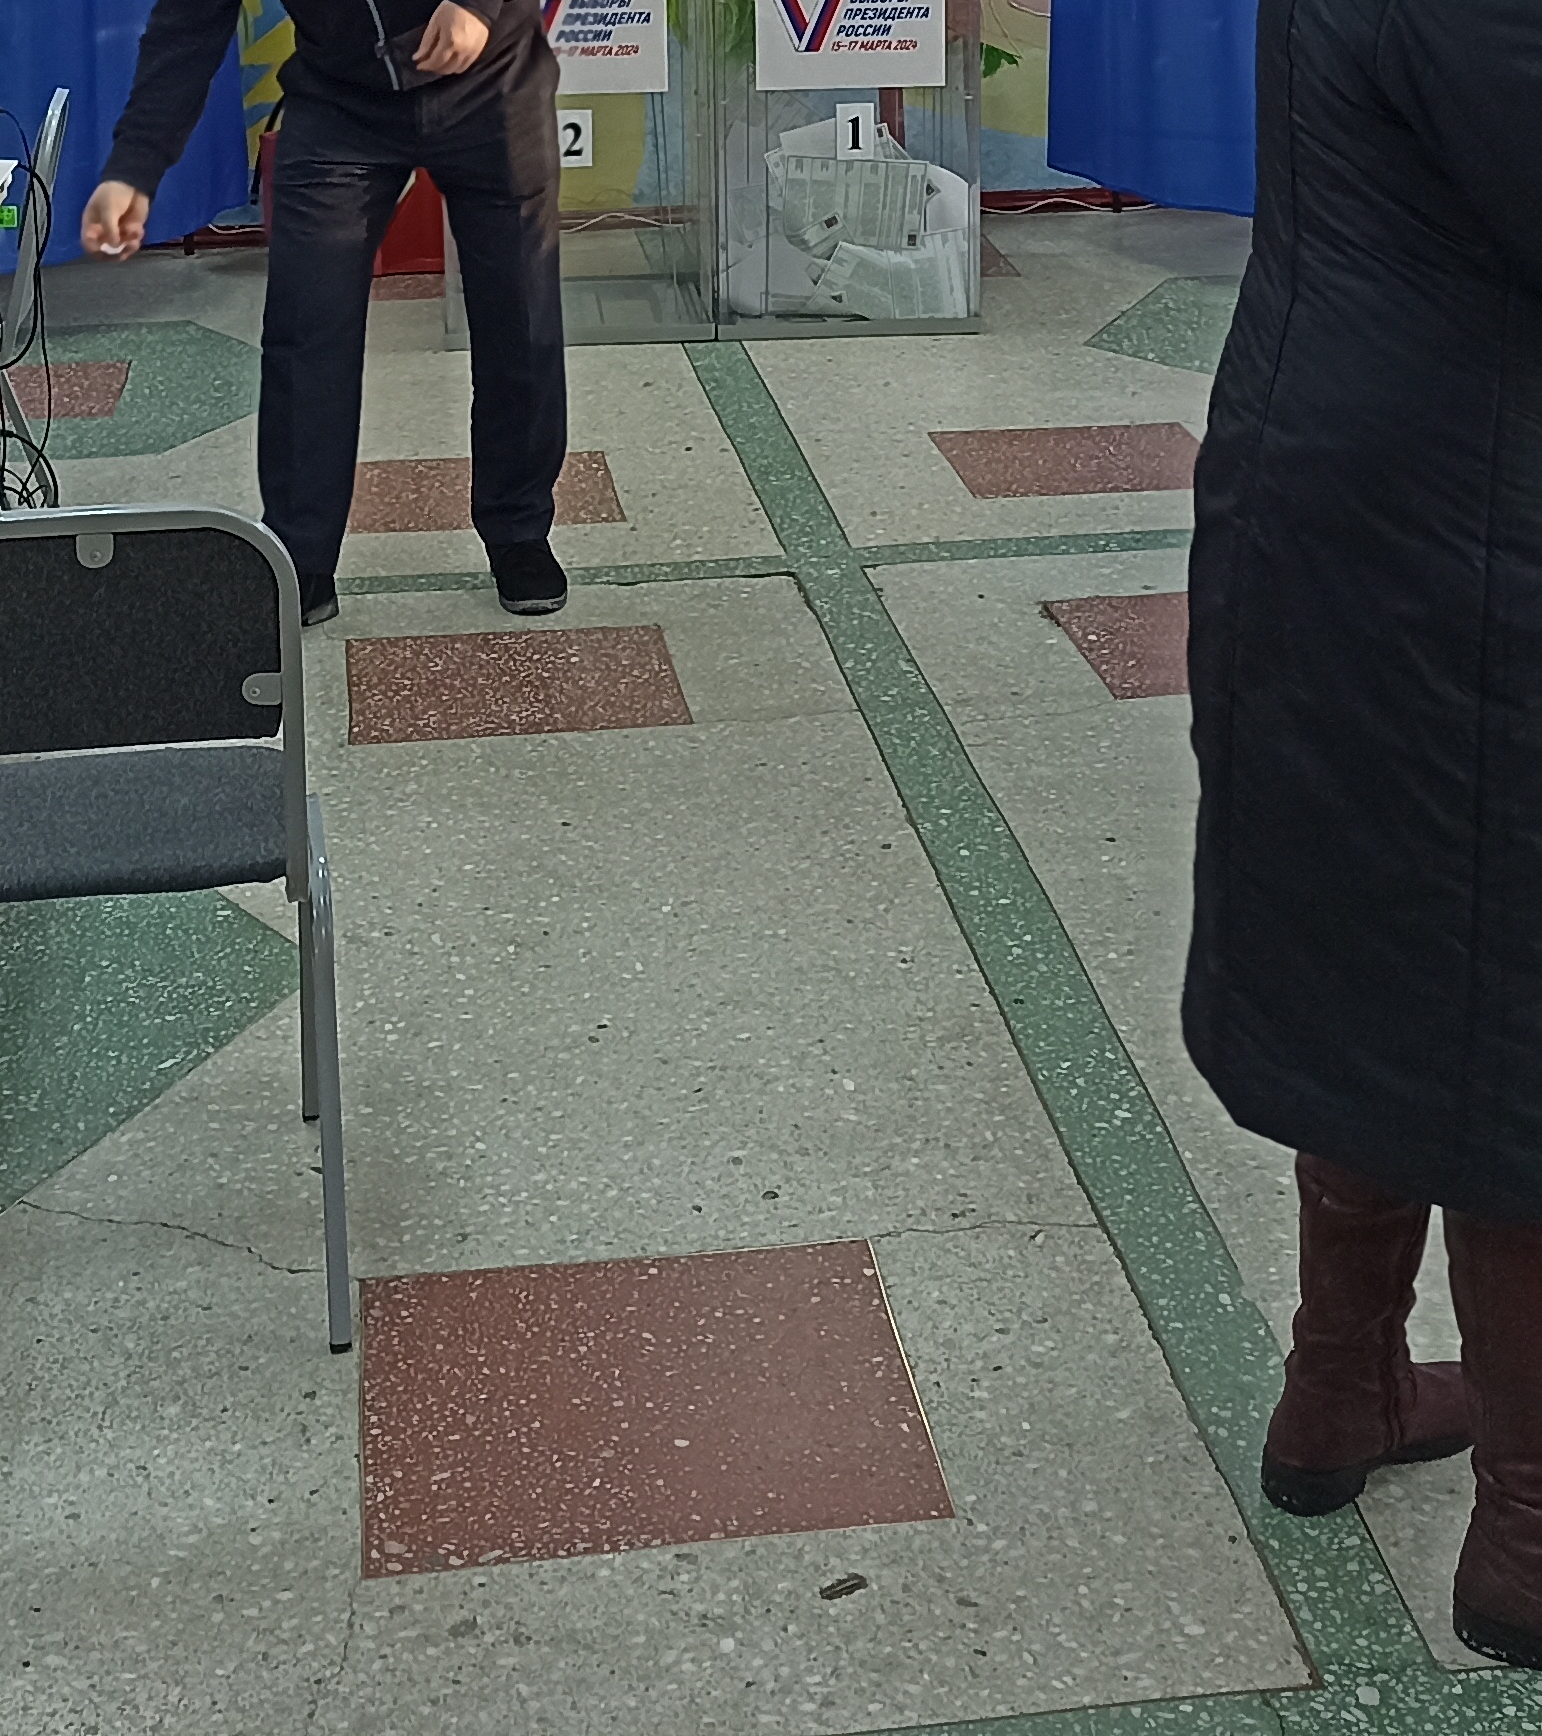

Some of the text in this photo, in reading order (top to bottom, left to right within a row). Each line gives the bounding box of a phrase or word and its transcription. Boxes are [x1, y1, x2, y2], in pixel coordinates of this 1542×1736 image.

[562, 11, 651, 27] ПРЕЗИДЕНТА
[843, 7, 930, 22] ПРЕЗИДЕНТА
[555, 29, 613, 43] РОССИИ
[836, 24, 893, 37] РОССИИ
[579, 45, 614, 57] МАРТА
[858, 39, 893, 51] МАРТА
[893, 39, 918, 51] 2024
[562, 122, 583, 157] 2
[846, 115, 864, 150] 1
